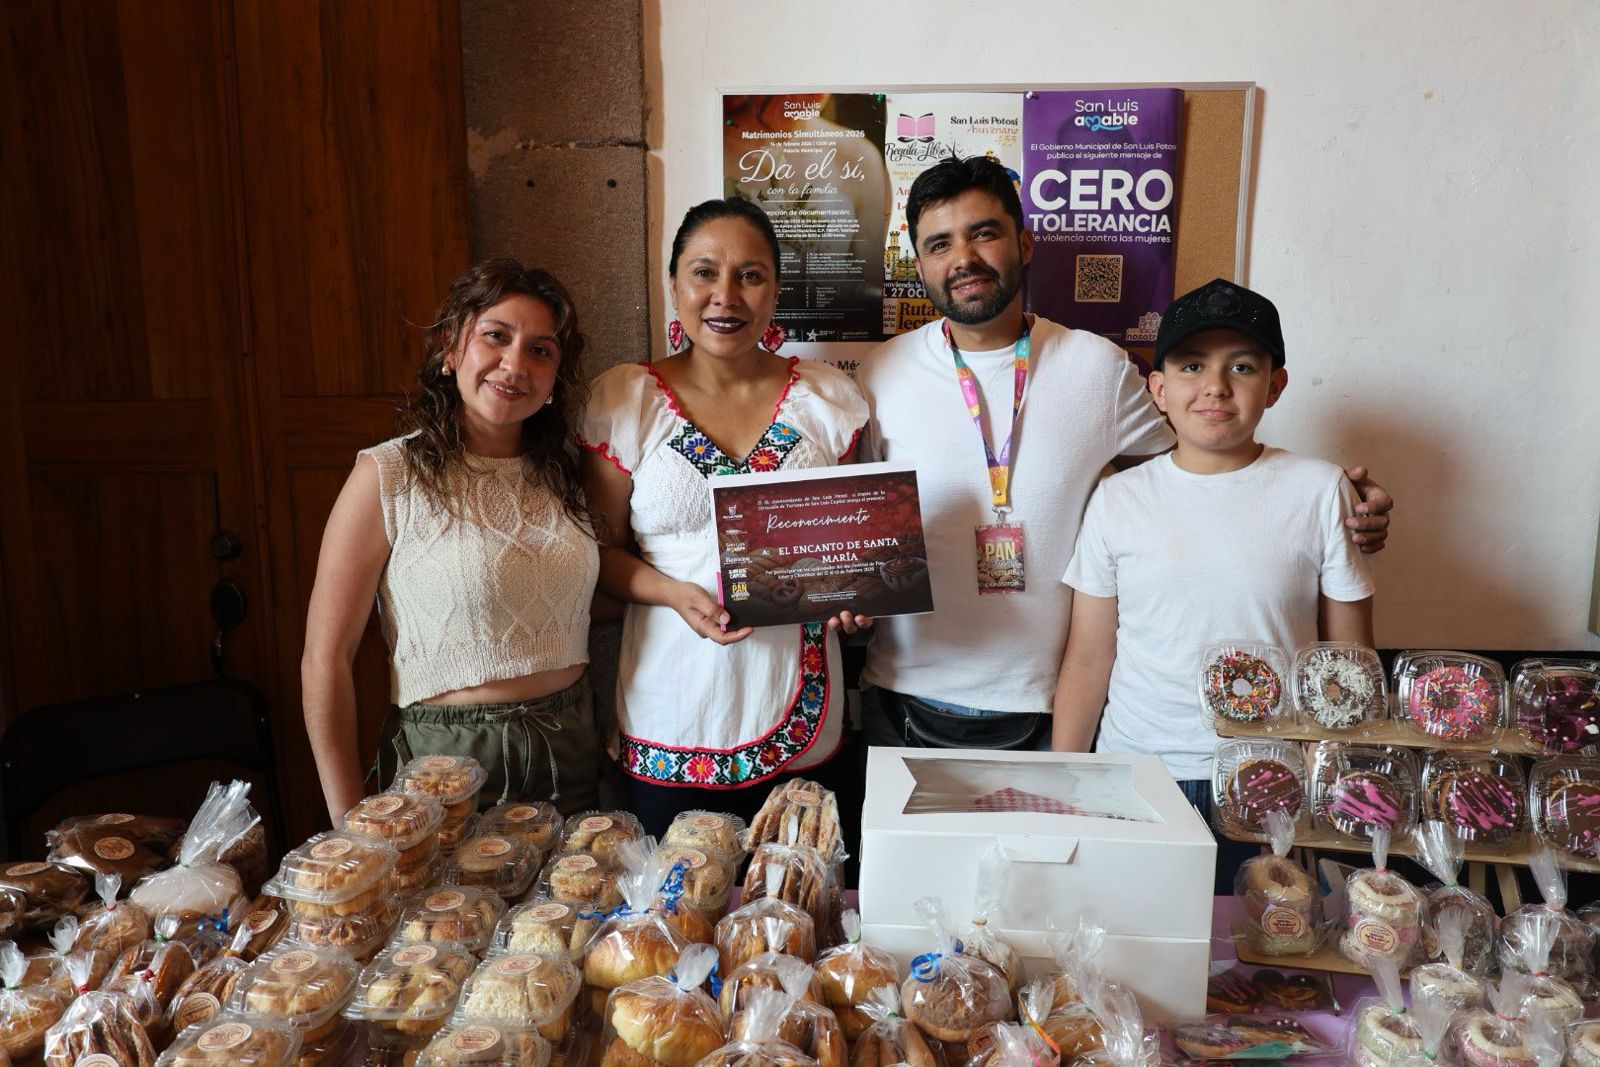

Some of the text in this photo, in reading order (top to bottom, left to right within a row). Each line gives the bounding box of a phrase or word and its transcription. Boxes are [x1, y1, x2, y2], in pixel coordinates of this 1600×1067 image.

[784, 101, 820, 110] San Luis
[1075, 99, 1139, 112] San Luis
[950, 116, 967, 125] San
[969, 116, 989, 125] Luis
[1074, 113, 1138, 131] amable
[742, 130, 866, 140] Matrimonios Simultáneos 2026
[1075, 142, 1110, 151] Municipal
[1047, 152, 1074, 160] publica
[1083, 152, 1118, 160] siguiente
[739, 148, 864, 182] Da el sí,
[767, 182, 839, 198] con la familia
[1030, 169, 1174, 211] CERO
[1028, 214, 1171, 232] TOLERANCIA
[1043, 234, 1084, 242] violencia
[1120, 234, 1133, 242] las
[1135, 234, 1171, 244] mujeres
[891, 288, 904, 297] 27
[900, 302, 936, 316] Ruta
[766, 507, 871, 533] Reconocimiento
[779, 547, 791, 556] EL
[793, 544, 844, 555] ENCANTO
[863, 537, 899, 548] SANTA
[985, 540, 1016, 560] PAN
[822, 552, 858, 564] MARÍA
[732, 584, 747, 592] PAN
